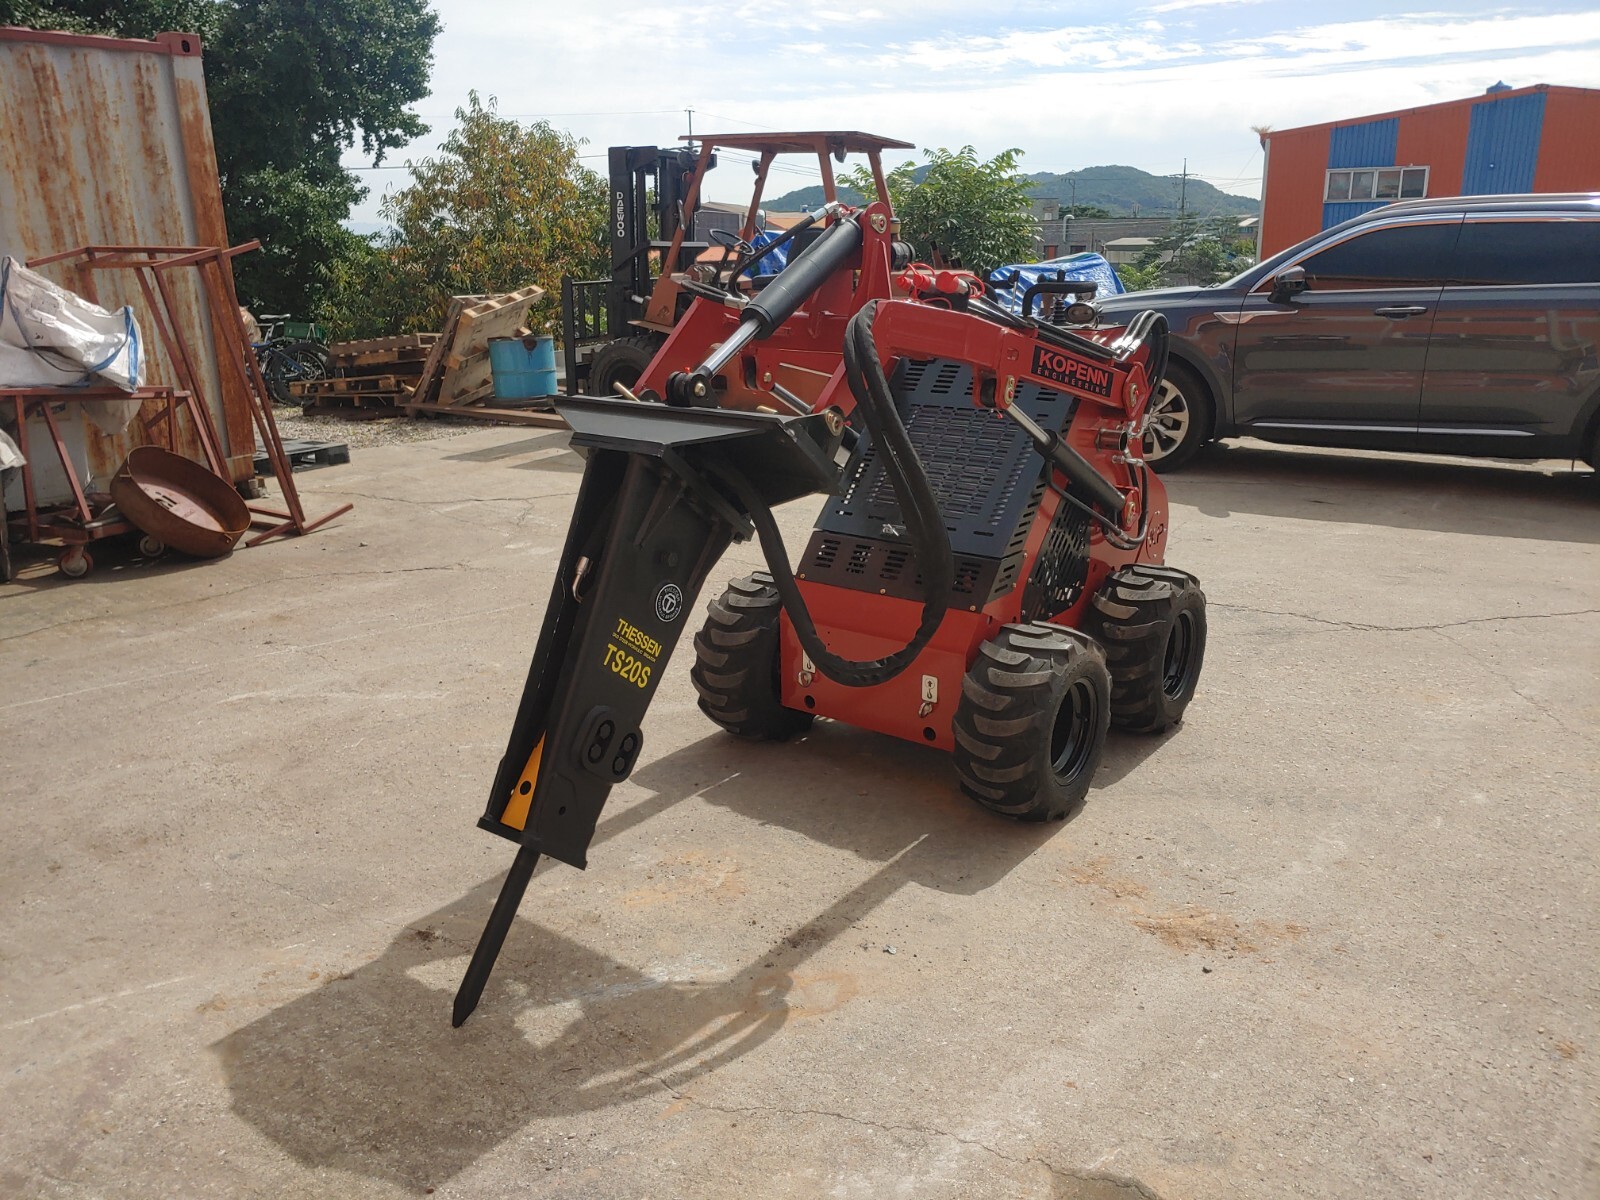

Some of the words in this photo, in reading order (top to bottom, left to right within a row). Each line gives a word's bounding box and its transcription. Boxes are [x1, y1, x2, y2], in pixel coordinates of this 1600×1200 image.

[616, 191, 625, 238] DAEWOO
[1037, 368, 1107, 395] ENGINEERING
[1039, 349, 1109, 388] KOPENN
[616, 618, 662, 658] THESSEN
[603, 643, 651, 689] TS20S
